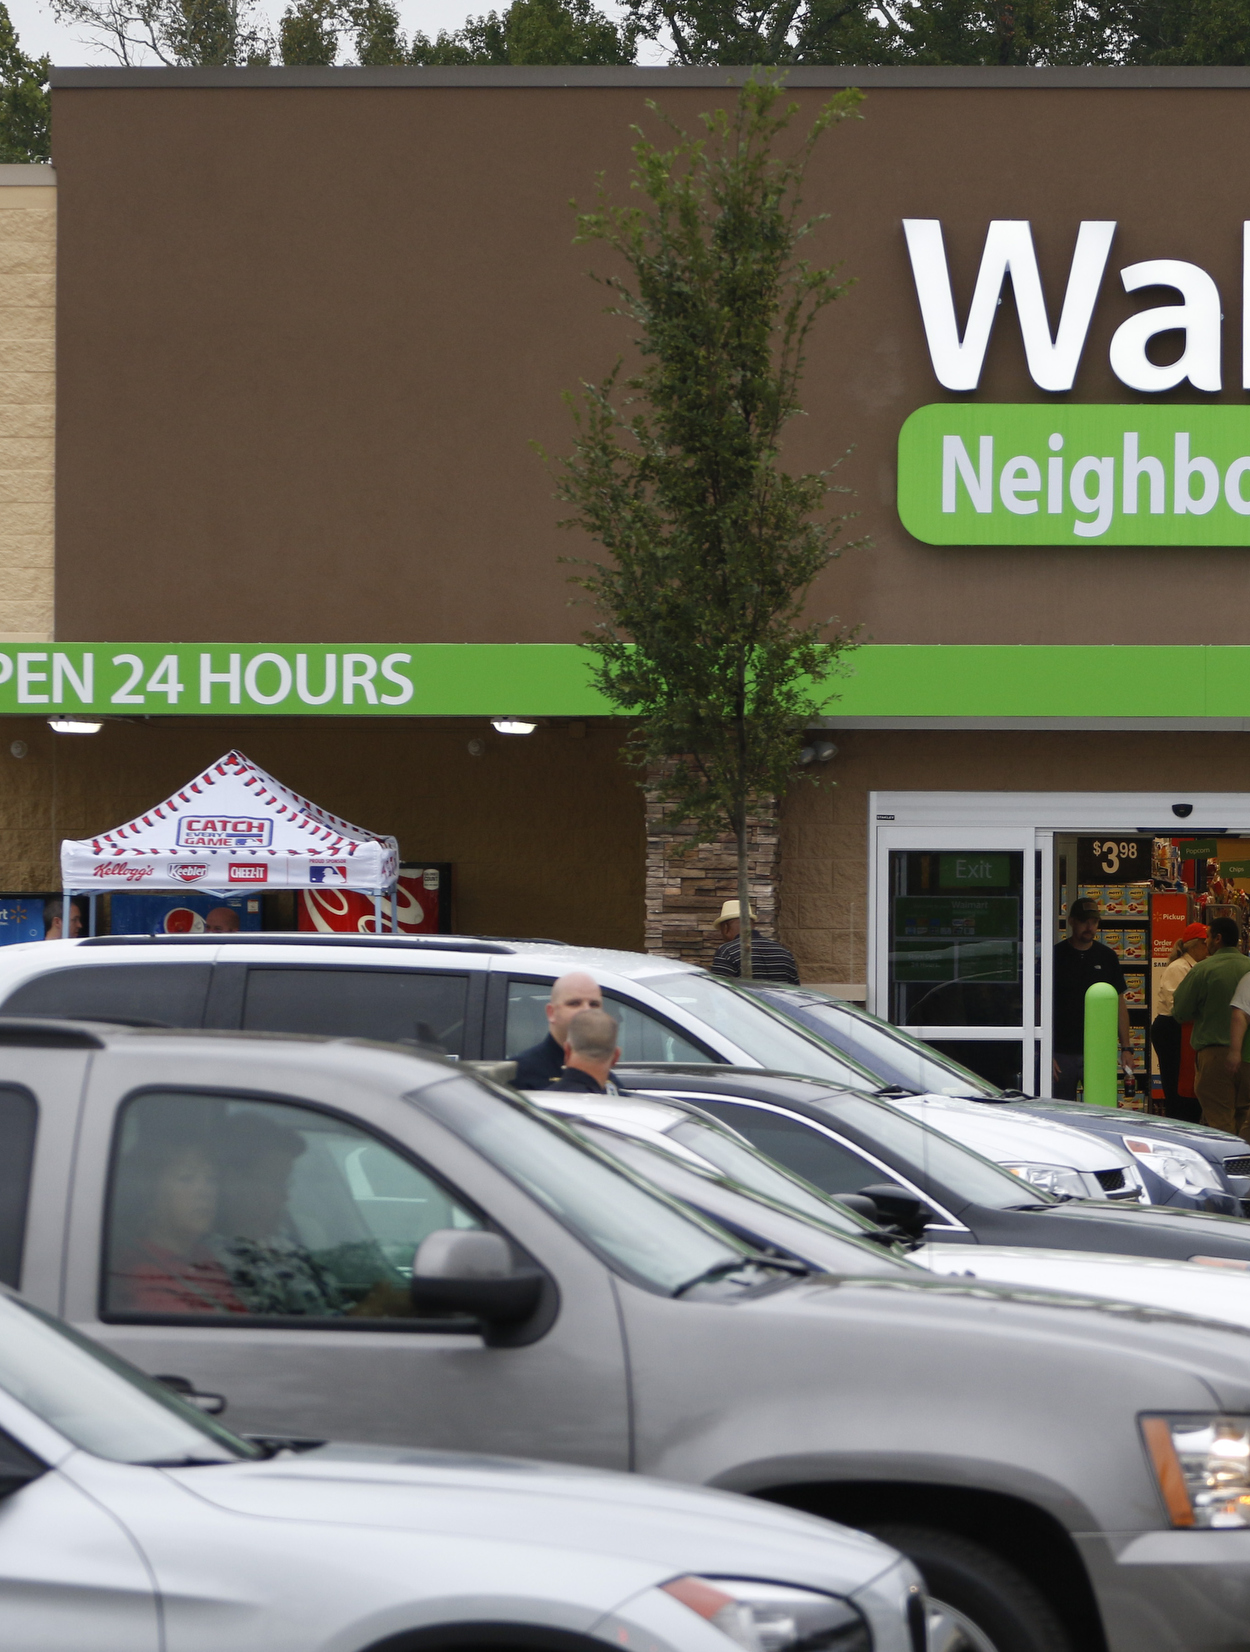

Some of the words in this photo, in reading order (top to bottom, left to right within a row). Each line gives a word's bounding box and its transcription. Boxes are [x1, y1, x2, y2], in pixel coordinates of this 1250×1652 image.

[110, 653, 184, 704] 24
[200, 652, 414, 705] HOURS
[186, 819, 265, 833] CATCH
[184, 838, 233, 846] GAME
[1092, 840, 1138, 874] $398
[1185, 847, 1211, 855] Popcorn
[93, 862, 154, 882] Kellogg's
[168, 864, 207, 876] Keebler
[230, 865, 265, 878] CHEEZ-IT
[955, 860, 993, 878] Exit
[1229, 865, 1244, 873] Chips
[951, 901, 989, 909] Walmart
[1162, 913, 1185, 922] Pickup
